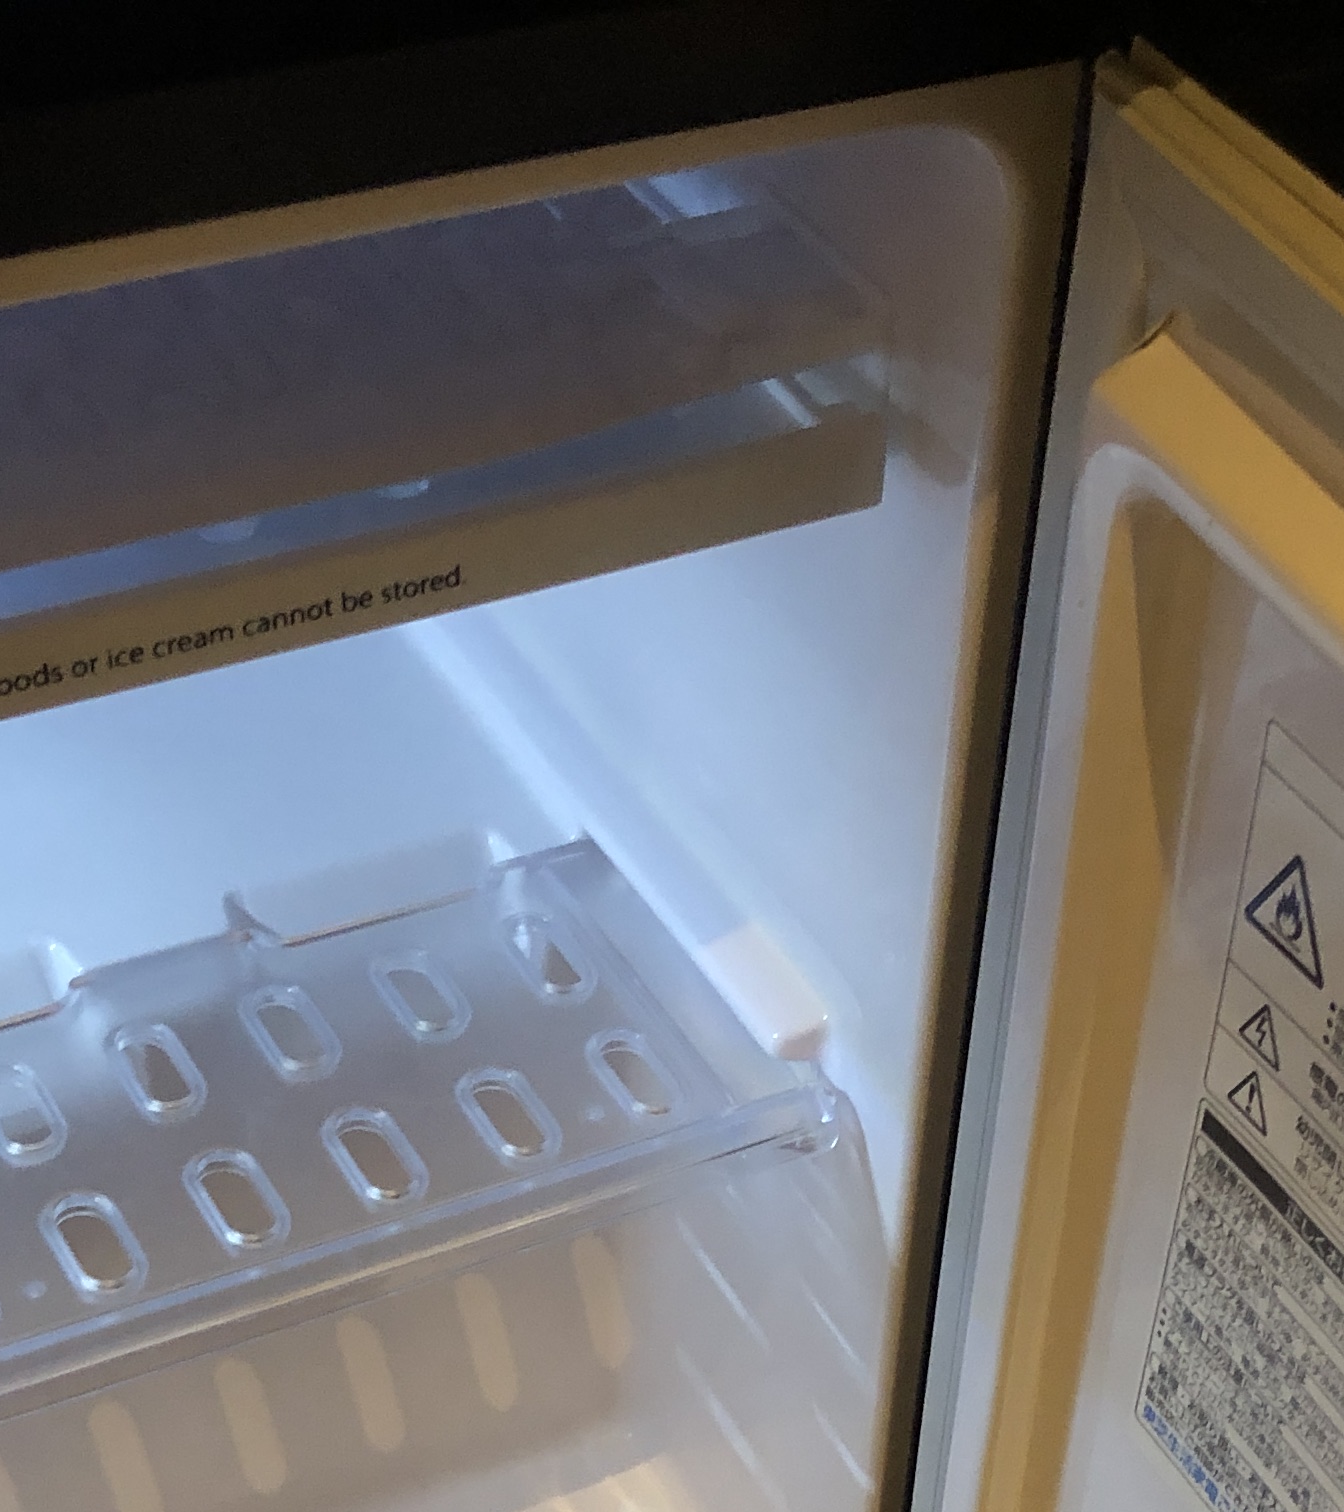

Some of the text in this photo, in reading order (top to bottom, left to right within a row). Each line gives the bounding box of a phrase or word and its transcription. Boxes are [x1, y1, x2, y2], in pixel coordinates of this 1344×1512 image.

[71, 653, 99, 678] or
[106, 642, 144, 671] ice
[152, 621, 235, 660] cream
[242, 596, 334, 638] cannot
[341, 587, 374, 614] be
